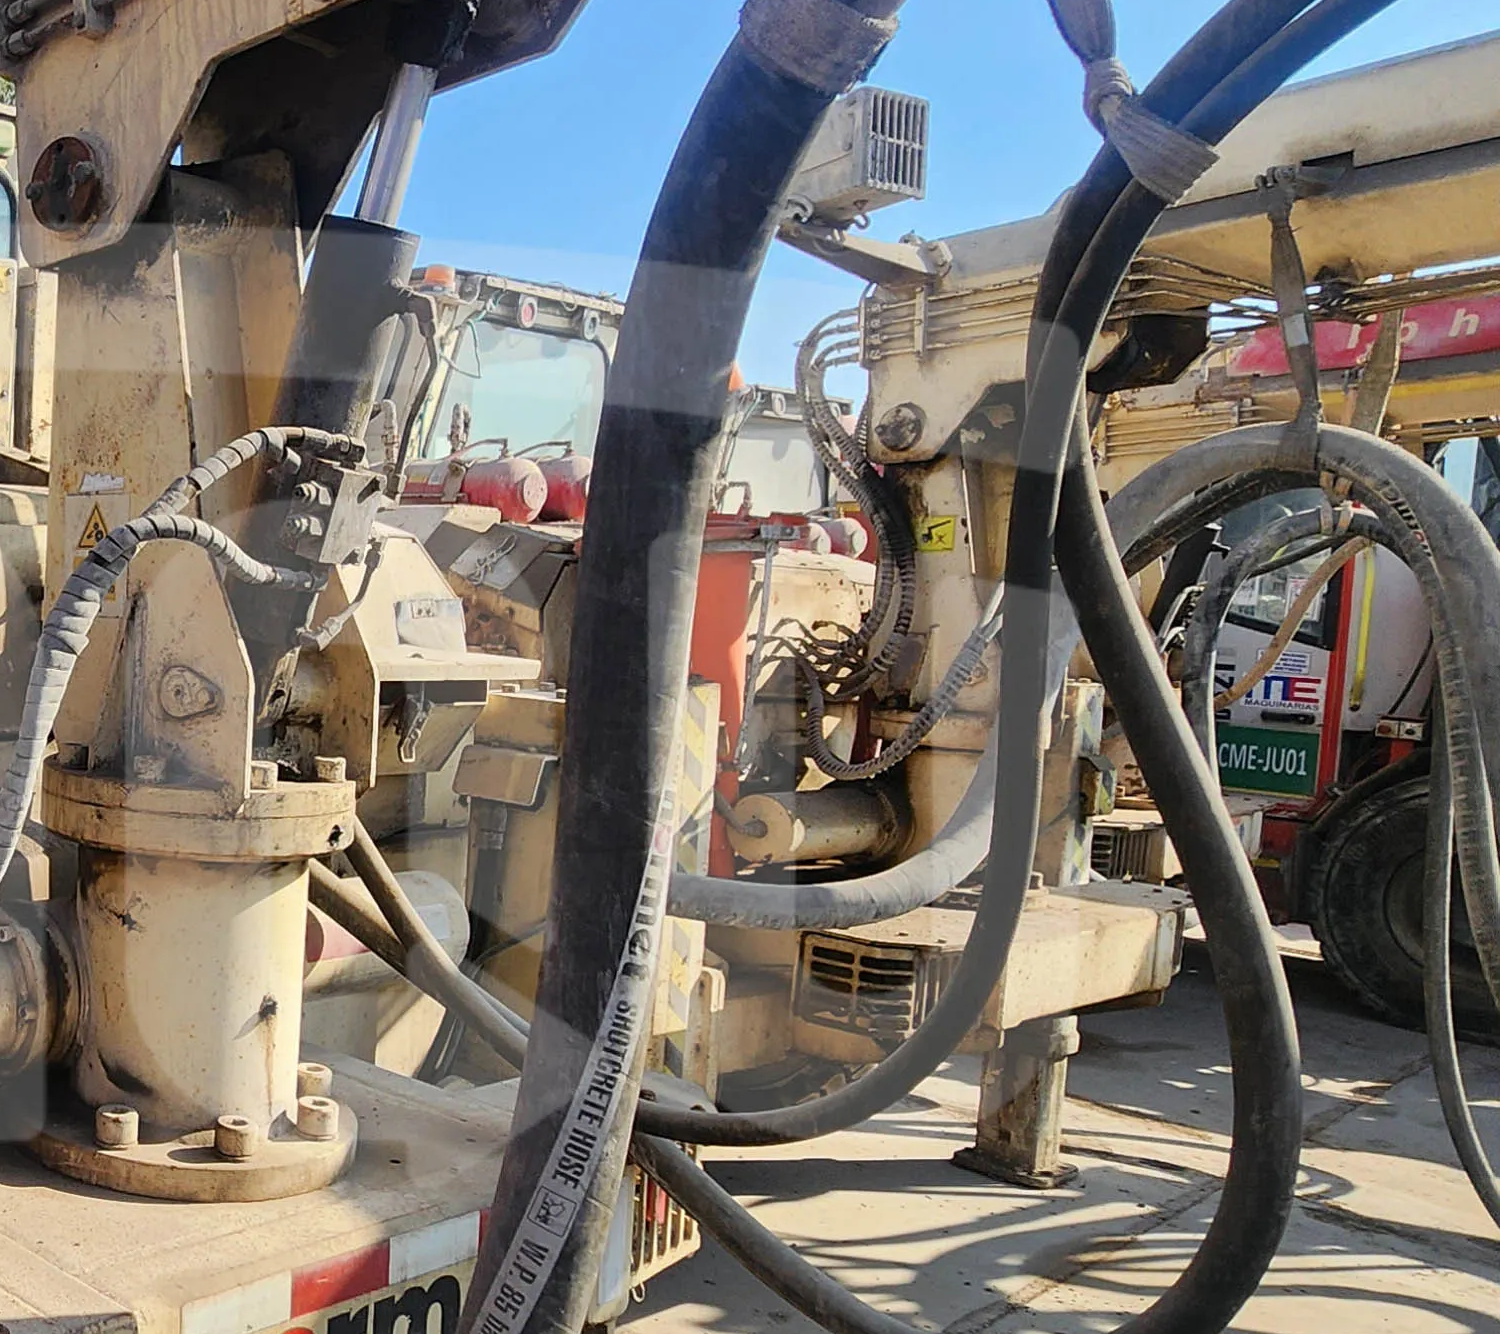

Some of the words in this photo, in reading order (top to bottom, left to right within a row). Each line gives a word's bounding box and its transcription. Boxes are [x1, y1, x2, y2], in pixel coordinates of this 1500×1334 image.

[1243, 697, 1320, 712] MAQUINARIAS
[1218, 741, 1308, 776] CME-JU01
[577, 999, 638, 1129] SHOTCRETE
[551, 1127, 597, 1190] HOSE
[509, 1238, 549, 1286] W.P.
[493, 1283, 526, 1320] 85
